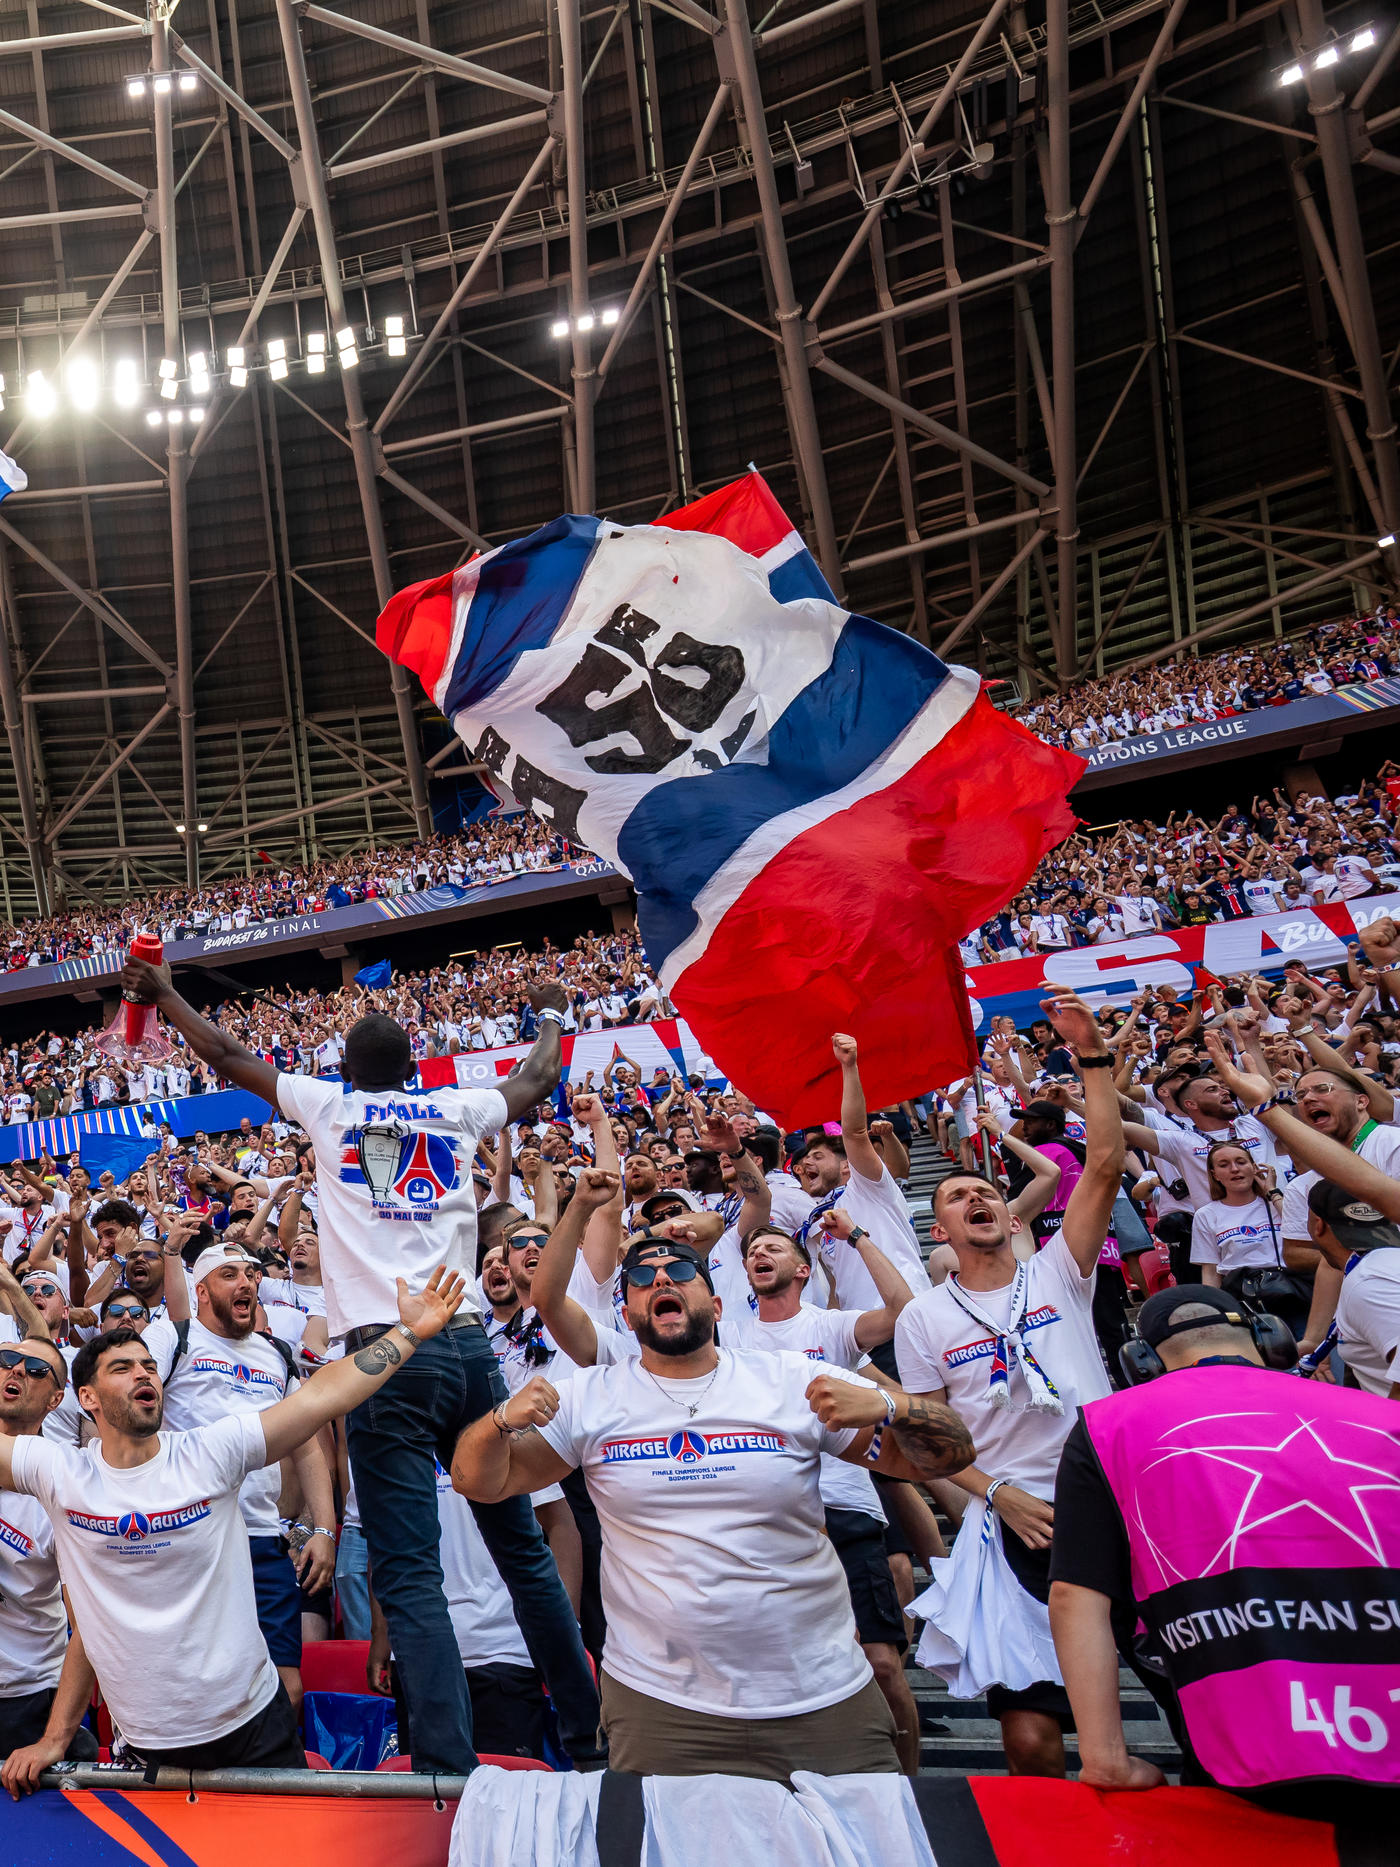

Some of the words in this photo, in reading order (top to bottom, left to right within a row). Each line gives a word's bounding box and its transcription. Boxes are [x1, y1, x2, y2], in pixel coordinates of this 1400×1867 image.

[1165, 720, 1247, 749] LEAGUE
[203, 930, 253, 951] BUDAPEST
[253, 927, 268, 941] 26
[273, 918, 321, 936] FINAL
[394, 1211, 412, 1221] MAI
[195, 1359, 233, 1373] VIRAGE
[947, 1341, 996, 1365] VIRAGE
[605, 1440, 665, 1460] VIRAGE
[709, 1434, 783, 1452] AUTEUIL
[675, 1467, 710, 1475] CHAMPIONS
[70, 1512, 115, 1534] VIRAGE
[152, 1501, 210, 1531] AUTEUIL
[1159, 1598, 1275, 1653] VISITING
[1275, 1600, 1358, 1631] FAN
